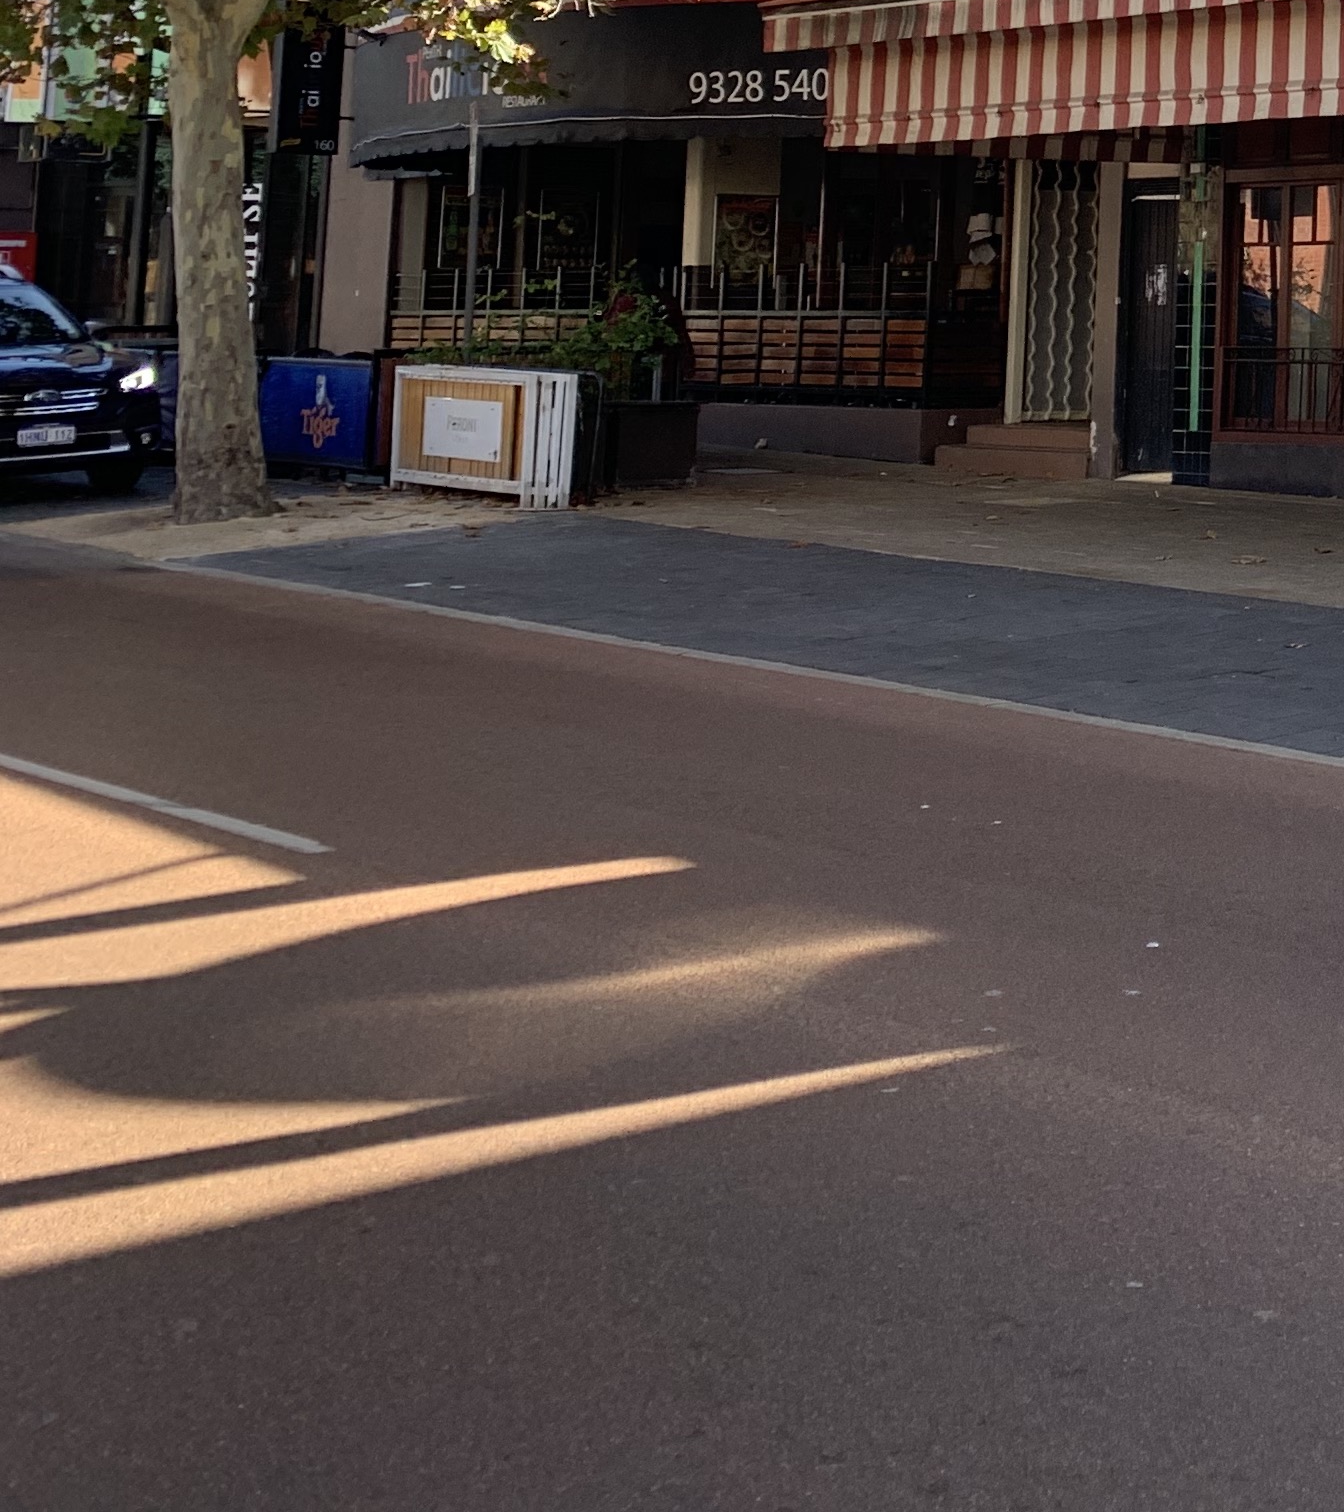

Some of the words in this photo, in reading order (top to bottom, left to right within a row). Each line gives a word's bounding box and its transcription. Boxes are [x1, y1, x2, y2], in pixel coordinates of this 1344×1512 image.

[689, 70, 764, 104] 9328
[773, 68, 828, 101] 540
[314, 140, 335, 151] 160
[300, 406, 340, 448] Tiger
